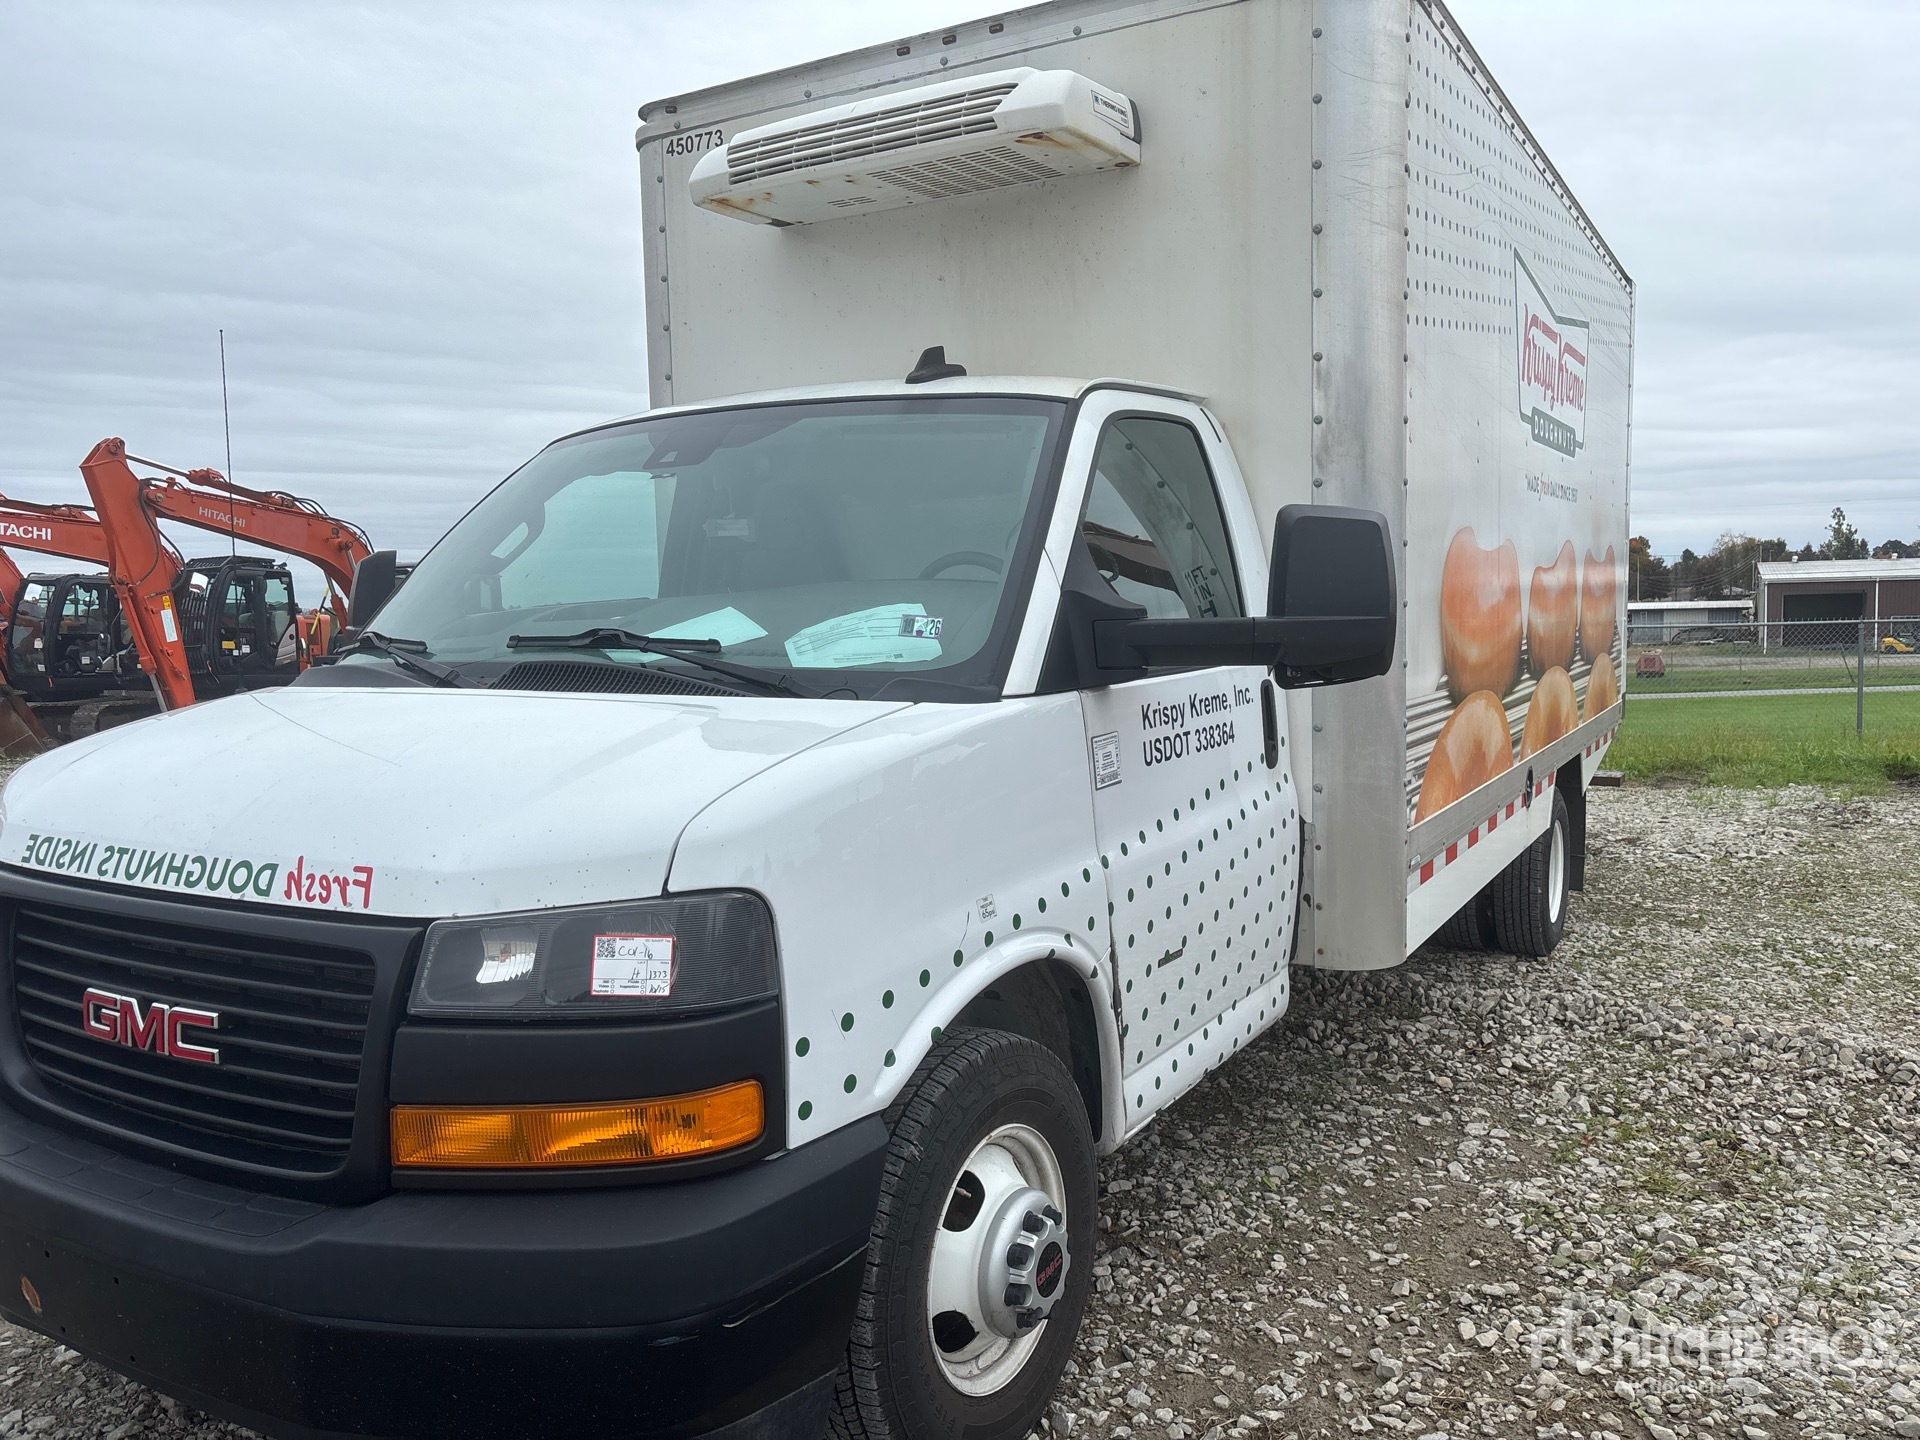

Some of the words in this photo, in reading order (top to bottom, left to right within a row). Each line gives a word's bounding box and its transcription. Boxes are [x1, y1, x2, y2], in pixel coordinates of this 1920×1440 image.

[665, 129, 723, 157] 450773
[1521, 303, 1558, 412] Krispy
[1556, 333, 1586, 412] Kreme
[1534, 414, 1574, 451] DOUGHNUTS
[198, 506, 246, 528] HITACHI
[928, 619, 941, 636] 26
[1141, 701, 1185, 730] Krispy
[1189, 693, 1232, 719] Kreme,
[1233, 684, 1254, 708] Inc.
[1142, 731, 1191, 767] USDOT
[1195, 720, 1236, 753] 338364
[82, 987, 220, 1065] GMC
[1036, 1252, 1063, 1287] GMC
